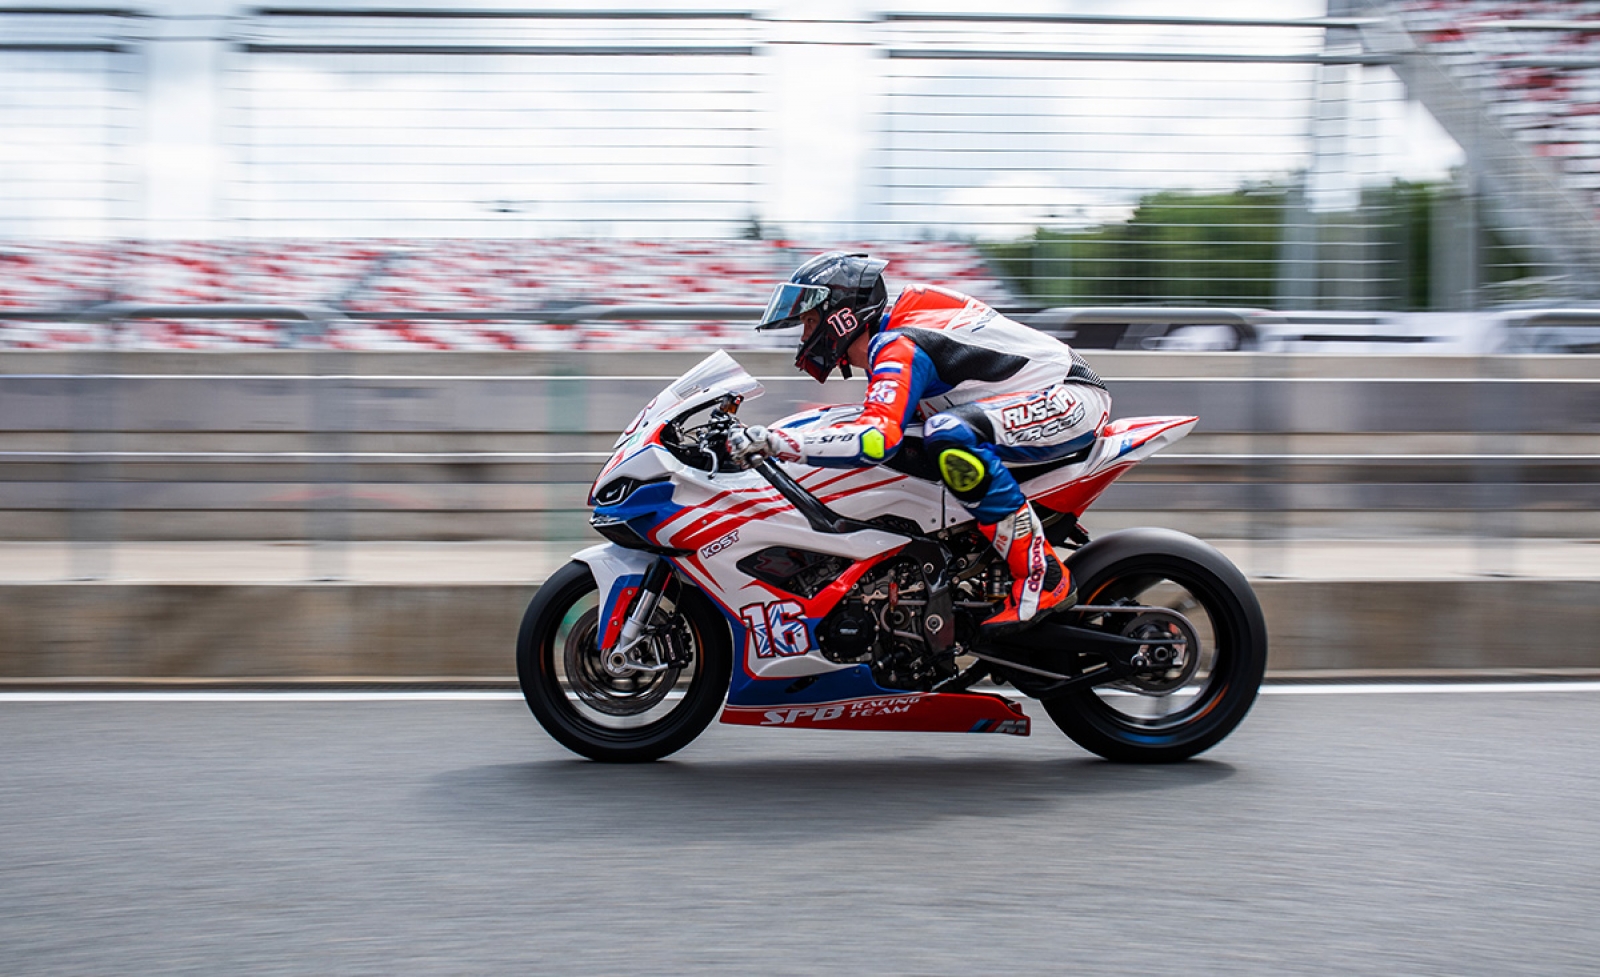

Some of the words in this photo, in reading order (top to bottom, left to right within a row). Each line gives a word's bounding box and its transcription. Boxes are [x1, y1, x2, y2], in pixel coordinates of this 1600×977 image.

[827, 307, 858, 337] 16
[1003, 388, 1075, 429] RUSSIA
[701, 530, 740, 559] KOST
[740, 599, 811, 658] 16
[760, 705, 845, 725] SPB
[850, 696, 921, 710] RACING
[850, 704, 911, 718] TEAM
